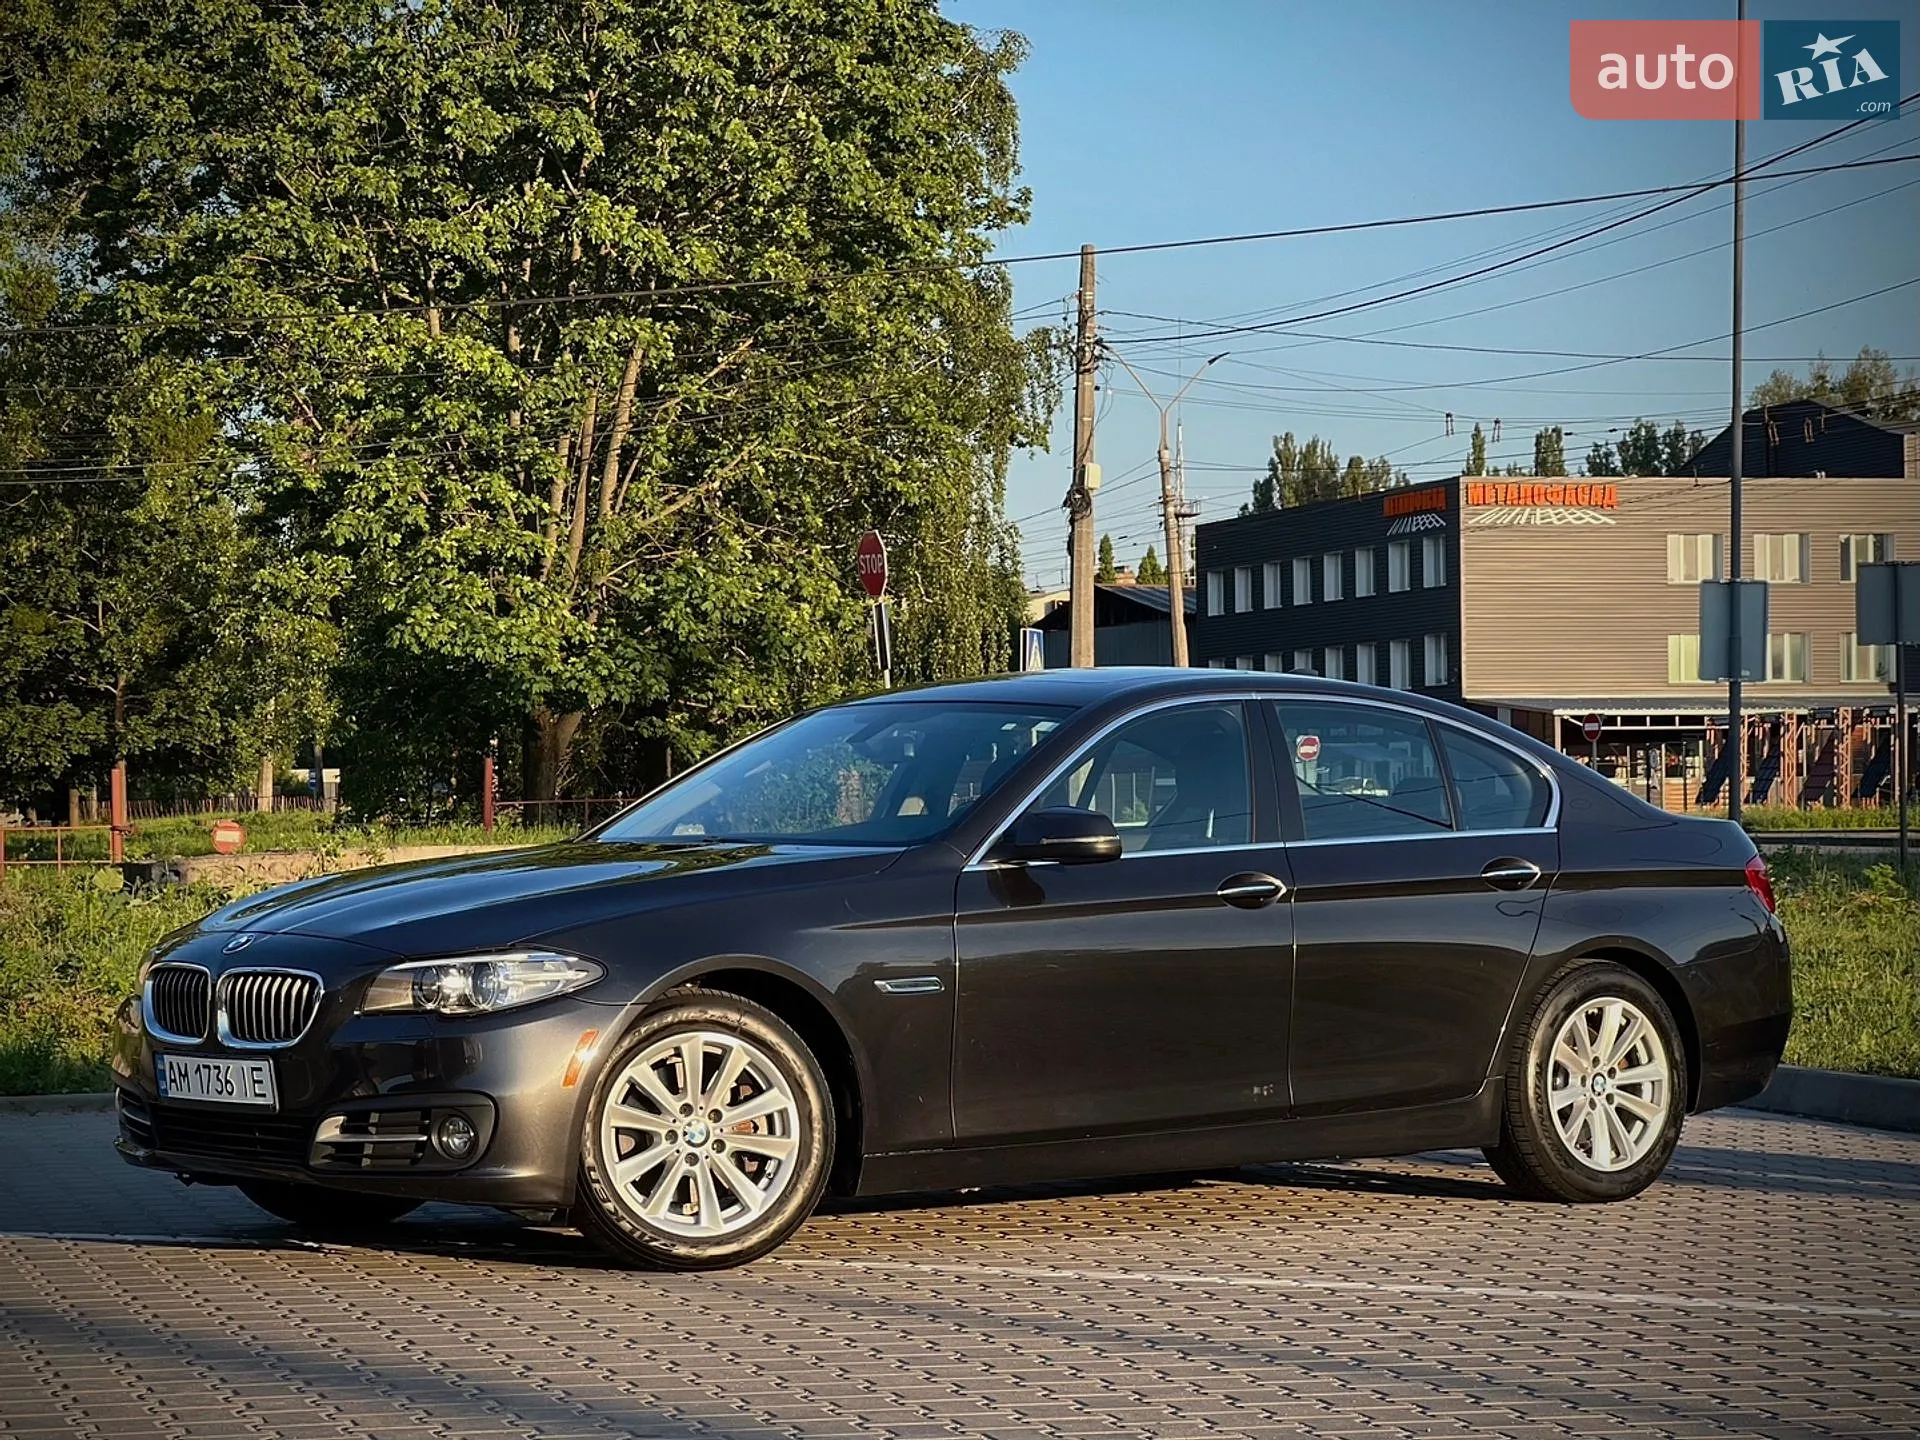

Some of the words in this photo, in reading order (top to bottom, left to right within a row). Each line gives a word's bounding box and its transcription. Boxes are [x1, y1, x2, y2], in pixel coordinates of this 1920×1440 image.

[1467, 482, 1619, 509] МЕТАЛОФАСАД
[859, 554, 883, 574] STOP
[169, 1060, 191, 1093] AM
[194, 1063, 235, 1097] 1736
[241, 1064, 267, 1098] IE
